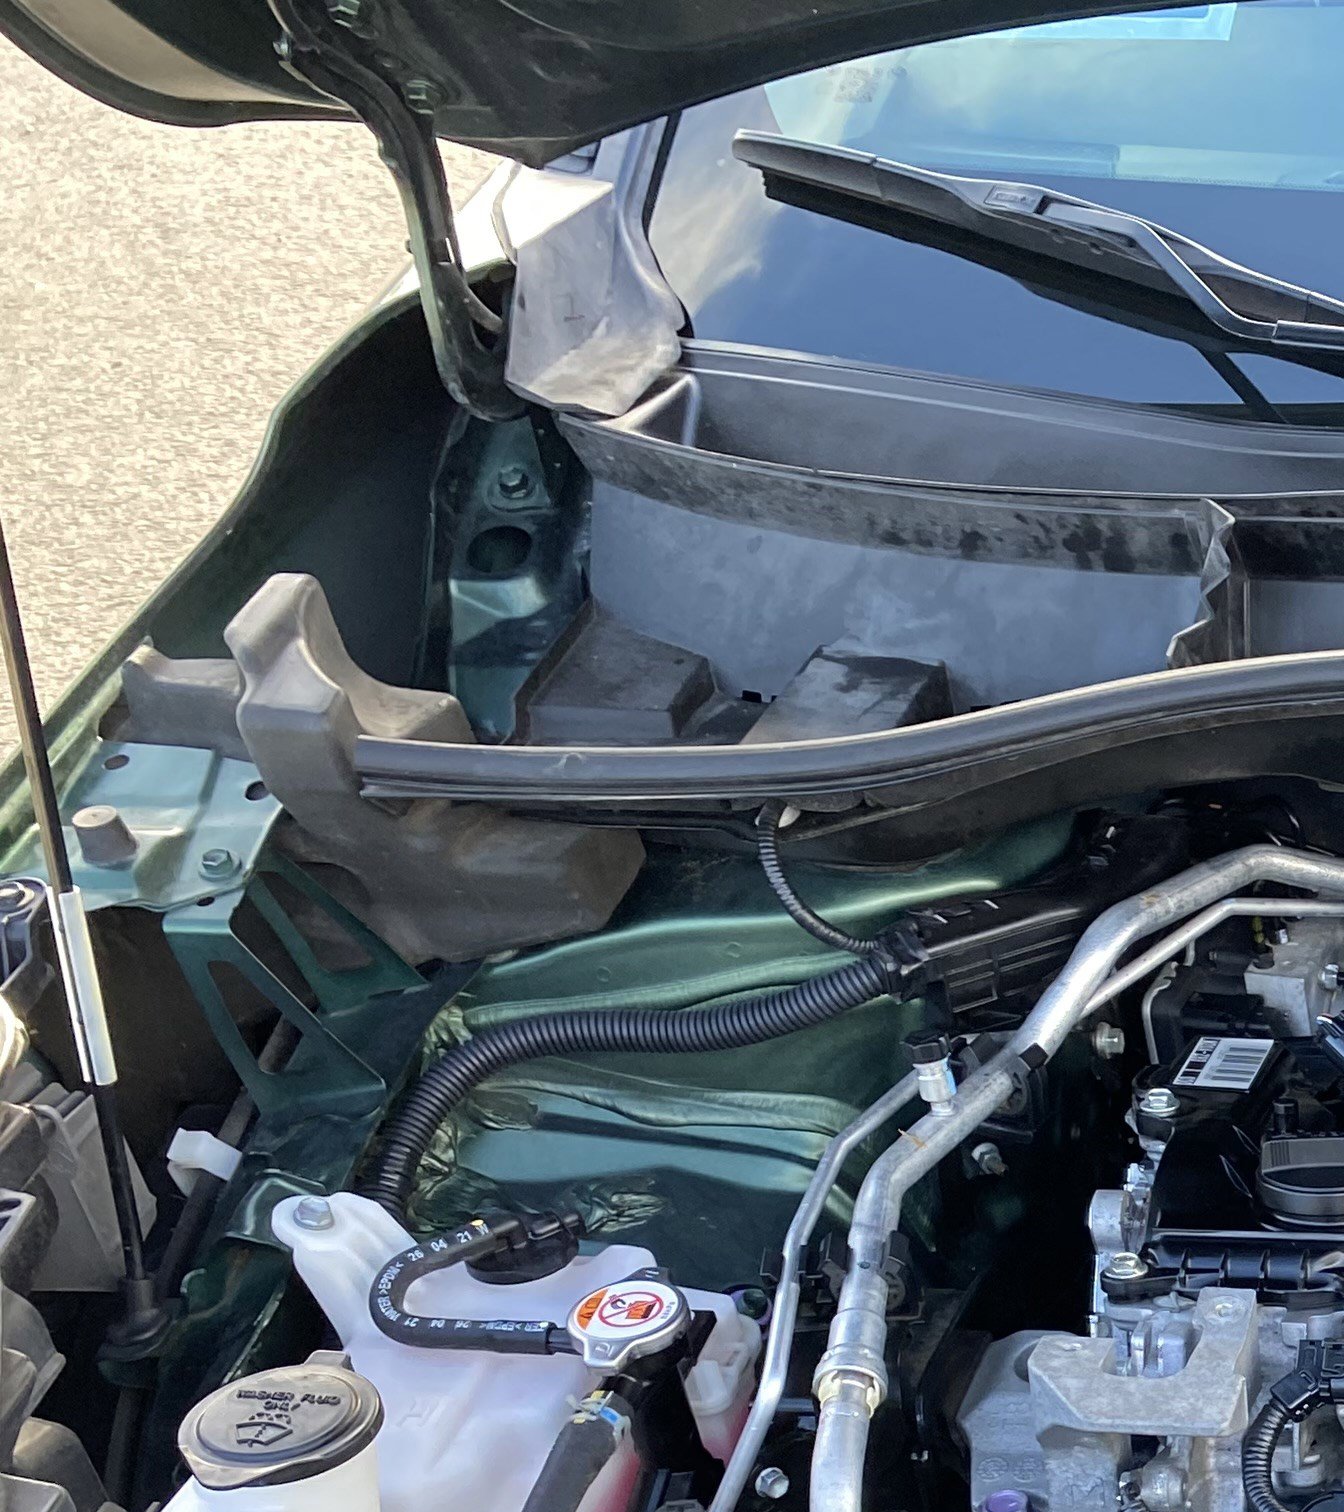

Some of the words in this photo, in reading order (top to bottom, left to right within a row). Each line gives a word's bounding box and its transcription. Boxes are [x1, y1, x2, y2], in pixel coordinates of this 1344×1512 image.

[407, 1249, 424, 1262] 26
[431, 1239, 448, 1252] 04
[457, 1230, 472, 1244] 21
